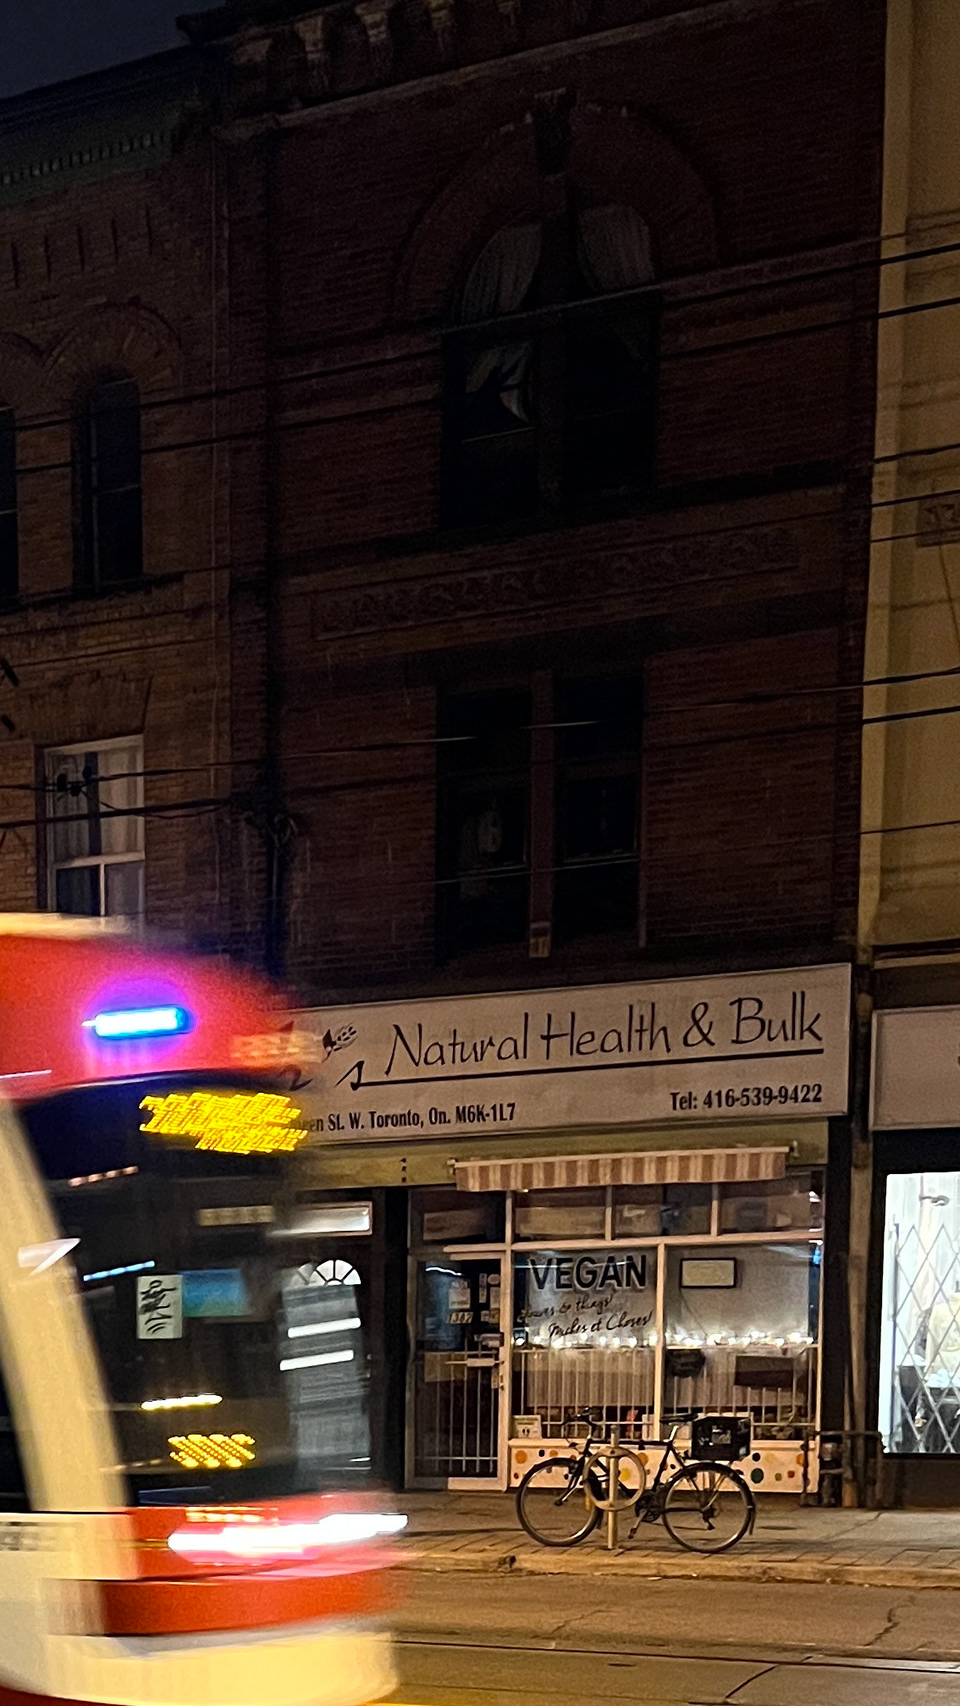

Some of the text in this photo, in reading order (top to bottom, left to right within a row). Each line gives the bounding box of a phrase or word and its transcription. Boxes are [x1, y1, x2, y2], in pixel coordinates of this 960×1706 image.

[384, 1012, 529, 1076] Natural
[540, 1002, 671, 1060] Health
[683, 1002, 716, 1046] &
[729, 991, 823, 1045] Bulk
[670, 1083, 823, 1111] Tel: 416-539-9422
[328, 1113, 345, 1132] St.
[349, 1112, 365, 1130] W.
[369, 1108, 424, 1129] Toronto,
[428, 1106, 451, 1125] On.
[455, 1102, 516, 1124] M6K-1L7
[530, 1255, 646, 1290] VEGAN
